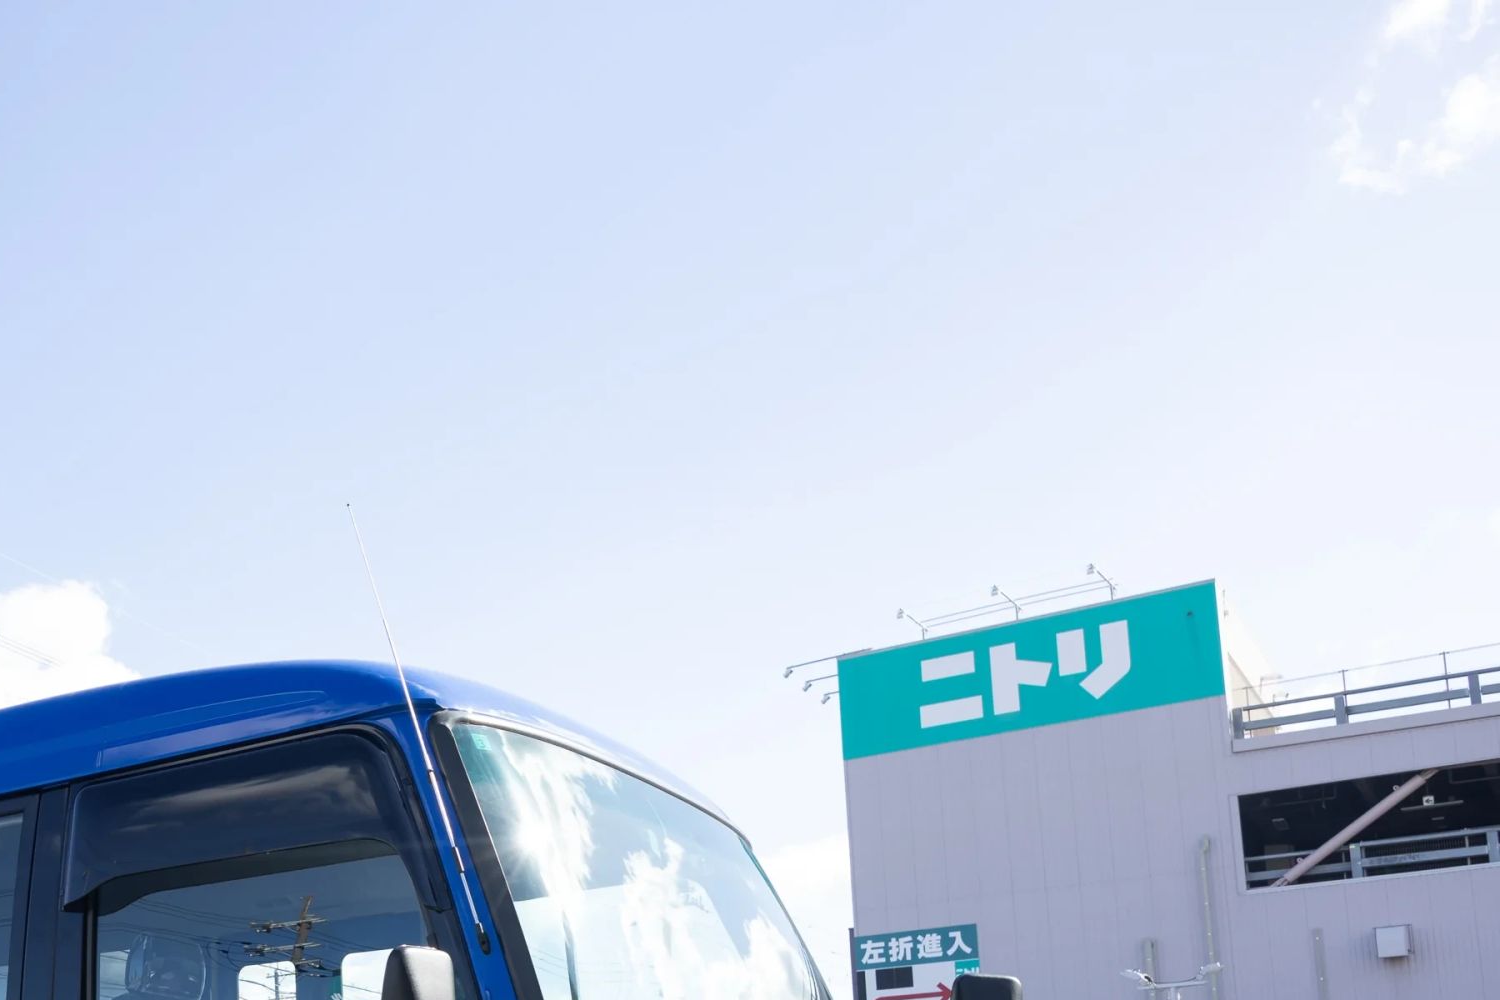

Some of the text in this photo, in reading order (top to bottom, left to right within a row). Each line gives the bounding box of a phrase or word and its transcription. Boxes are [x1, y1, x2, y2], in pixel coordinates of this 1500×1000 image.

[919, 619, 1132, 729] ニトリ
[860, 930, 973, 965] 左折進入
